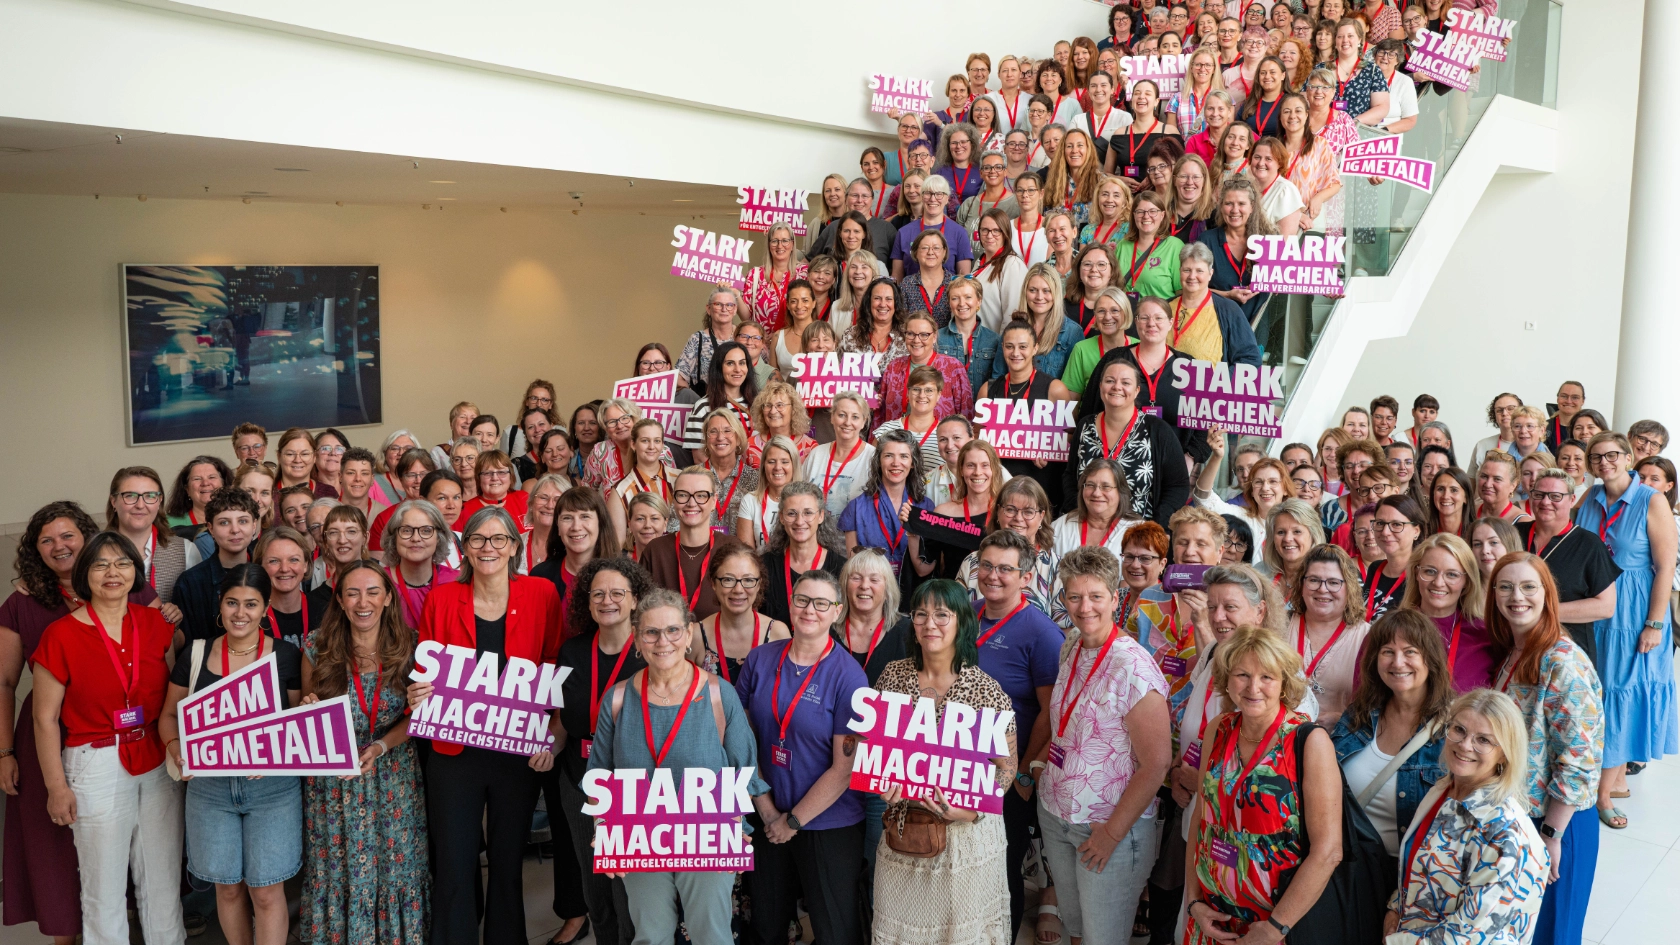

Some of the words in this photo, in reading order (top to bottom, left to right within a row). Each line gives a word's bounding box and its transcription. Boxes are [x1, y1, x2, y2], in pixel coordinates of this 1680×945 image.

[1444, 8, 1517, 39] STARK
[1412, 28, 1483, 67] STARK
[1119, 54, 1192, 76] STARK
[1408, 51, 1471, 85] MACHEN.
[868, 71, 934, 98] STARK
[872, 93, 932, 112] MACHEN.
[1348, 139, 1393, 157] TEAM
[1345, 161, 1360, 172] IG
[1361, 159, 1427, 187] METALL
[736, 184, 811, 211] STARK
[740, 208, 807, 229] MACHEN.
[670, 224, 754, 263] STARK
[1245, 234, 1347, 262] STARK
[672, 251, 746, 282] MACHEN.
[680, 268, 697, 279] FÜR
[1251, 264, 1344, 287] MACHEN.
[1253, 282, 1269, 291] FÜR
[1272, 284, 1340, 294] VEREINBARKEIT
[789, 352, 882, 378] STARK
[1171, 357, 1286, 399] STARK
[619, 378, 668, 400] TEAM
[796, 381, 879, 399] MACHEN.
[804, 396, 821, 407] FÜR
[972, 398, 1078, 428] STARK
[1178, 395, 1283, 426] MACHEN.
[1180, 416, 1198, 428] FÜR
[999, 448, 1070, 460] VEREINBARKEIT
[919, 509, 982, 536] Superheldin
[408, 640, 574, 708] STARK
[186, 673, 269, 730] TEAM
[411, 694, 556, 744] MACHEN.
[846, 686, 1016, 757] STARK
[191, 740, 218, 767] IG
[222, 712, 346, 765] METALL
[409, 720, 435, 738] FÜR
[438, 727, 551, 755] GLEICHSTELLUNG
[852, 742, 1005, 798] MACHEN.
[580, 766, 756, 816] STARK
[594, 822, 754, 856] MACHEN.
[595, 857, 617, 869] FÜR
[620, 857, 751, 869] ENTGELTGERECHTIGKEIT
